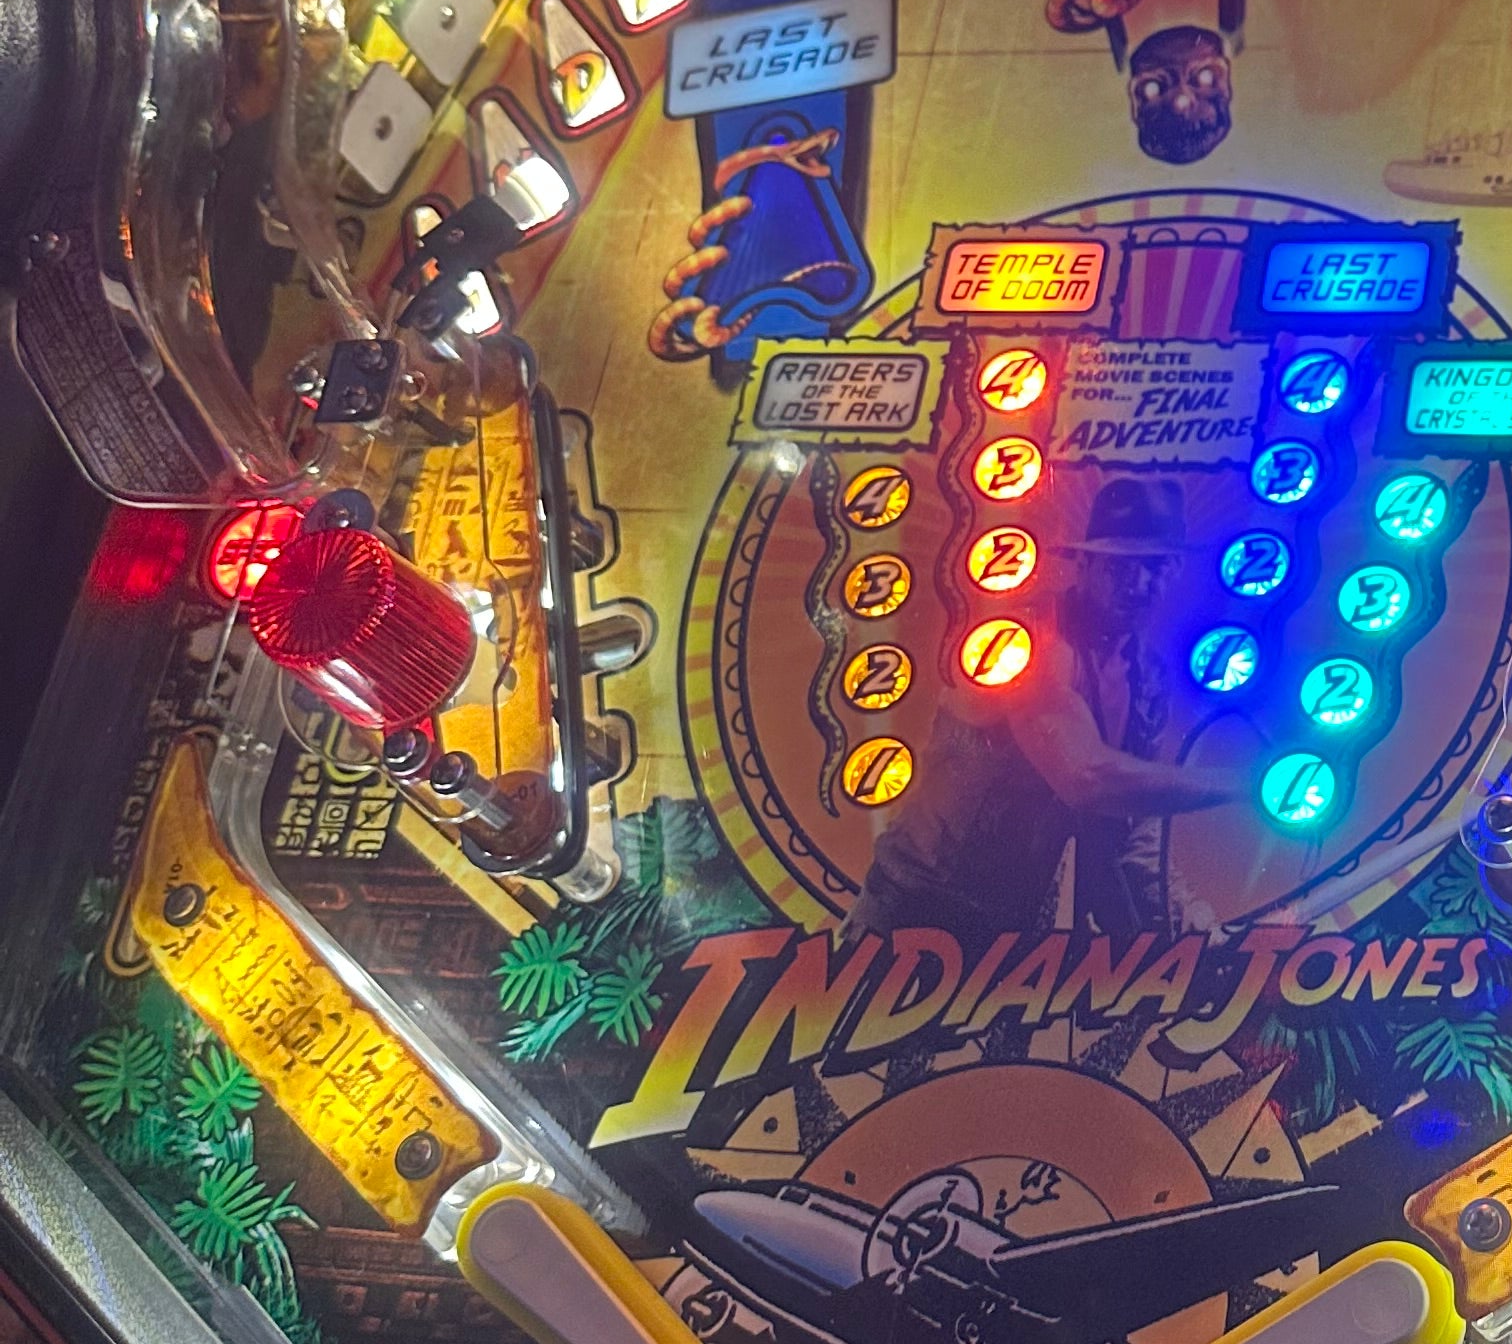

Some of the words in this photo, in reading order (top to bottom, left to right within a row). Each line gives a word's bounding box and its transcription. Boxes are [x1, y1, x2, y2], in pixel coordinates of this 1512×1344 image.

[709, 12, 847, 59] LAST
[679, 35, 880, 92] CRUSADE
[955, 254, 1097, 275] TEMPLE
[1302, 254, 1397, 275] LAST
[951, 280, 992, 299] OF
[1001, 280, 1090, 300] DOOM
[1272, 280, 1420, 301] CRUSADE
[1077, 351, 1192, 366] COMPLETE
[775, 363, 918, 382] RAIDERS
[1074, 370, 1144, 384] MOVIE
[1151, 370, 1234, 384] SCENES
[802, 385, 838, 400] OF
[841, 385, 882, 400] THE
[1071, 388, 1133, 401] FOR...
[1134, 387, 1231, 418] FINAL
[764, 403, 840, 422] LOST
[845, 403, 910, 423] ARK
[1059, 416, 1254, 453] ADVENTURE
[587, 926, 1201, 1149] INDIANA
[1169, 925, 1491, 1056] JONES
